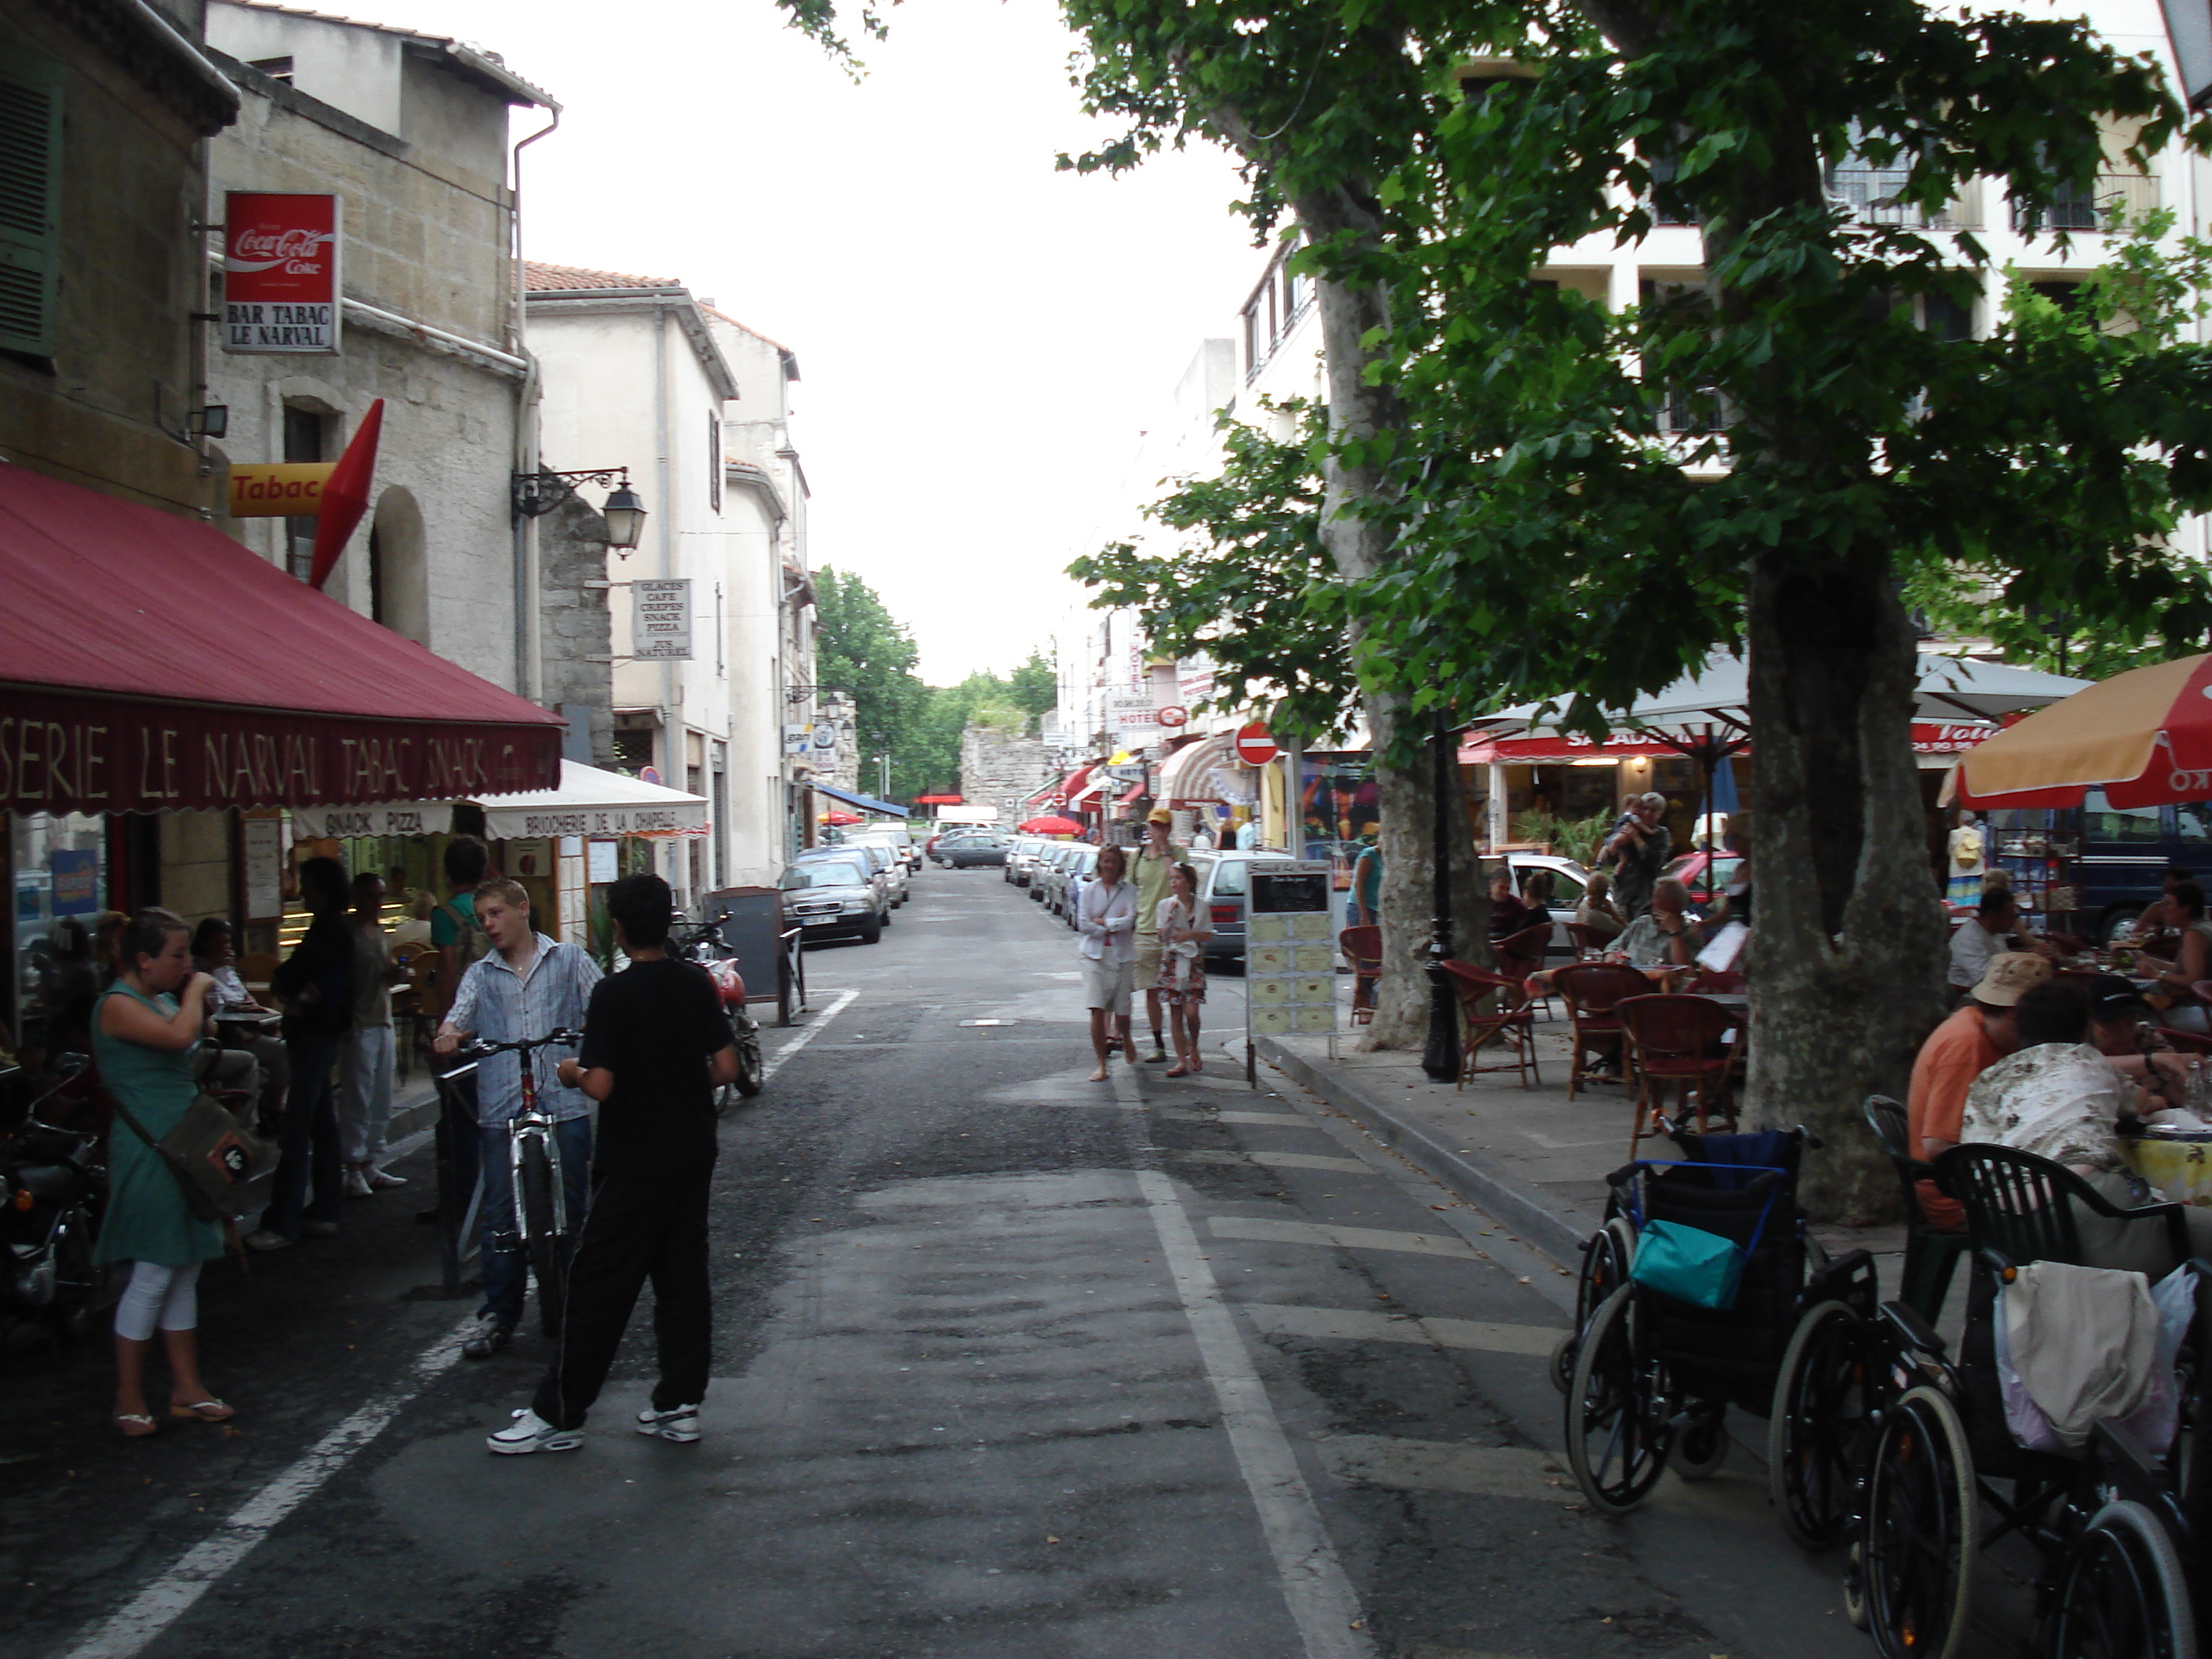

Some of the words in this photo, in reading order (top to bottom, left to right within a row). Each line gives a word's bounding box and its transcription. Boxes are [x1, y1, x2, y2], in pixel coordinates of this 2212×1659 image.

[228, 304, 264, 324] BAR
[273, 306, 329, 325] TABAC
[231, 325, 252, 344] LE
[258, 326, 324, 346] NARVAL
[233, 474, 318, 500] Tabac
[641, 582, 684, 591] GLACES
[643, 613, 682, 622] SNACK
[646, 623, 679, 632] PIZZA
[654, 640, 673, 649] JUS
[1131, 644, 1140, 693] HOTEL
[141, 726, 180, 799] LE
[203, 731, 321, 799] NARVAL
[341, 737, 411, 797] TABAC
[427, 738, 489, 789] SNACK
[325, 811, 373, 835] SNACK
[386, 811, 424, 833] PIZZA
[595, 812, 610, 831] DE
[614, 811, 628, 830] LA
[634, 811, 676, 830] CHAPELLE
